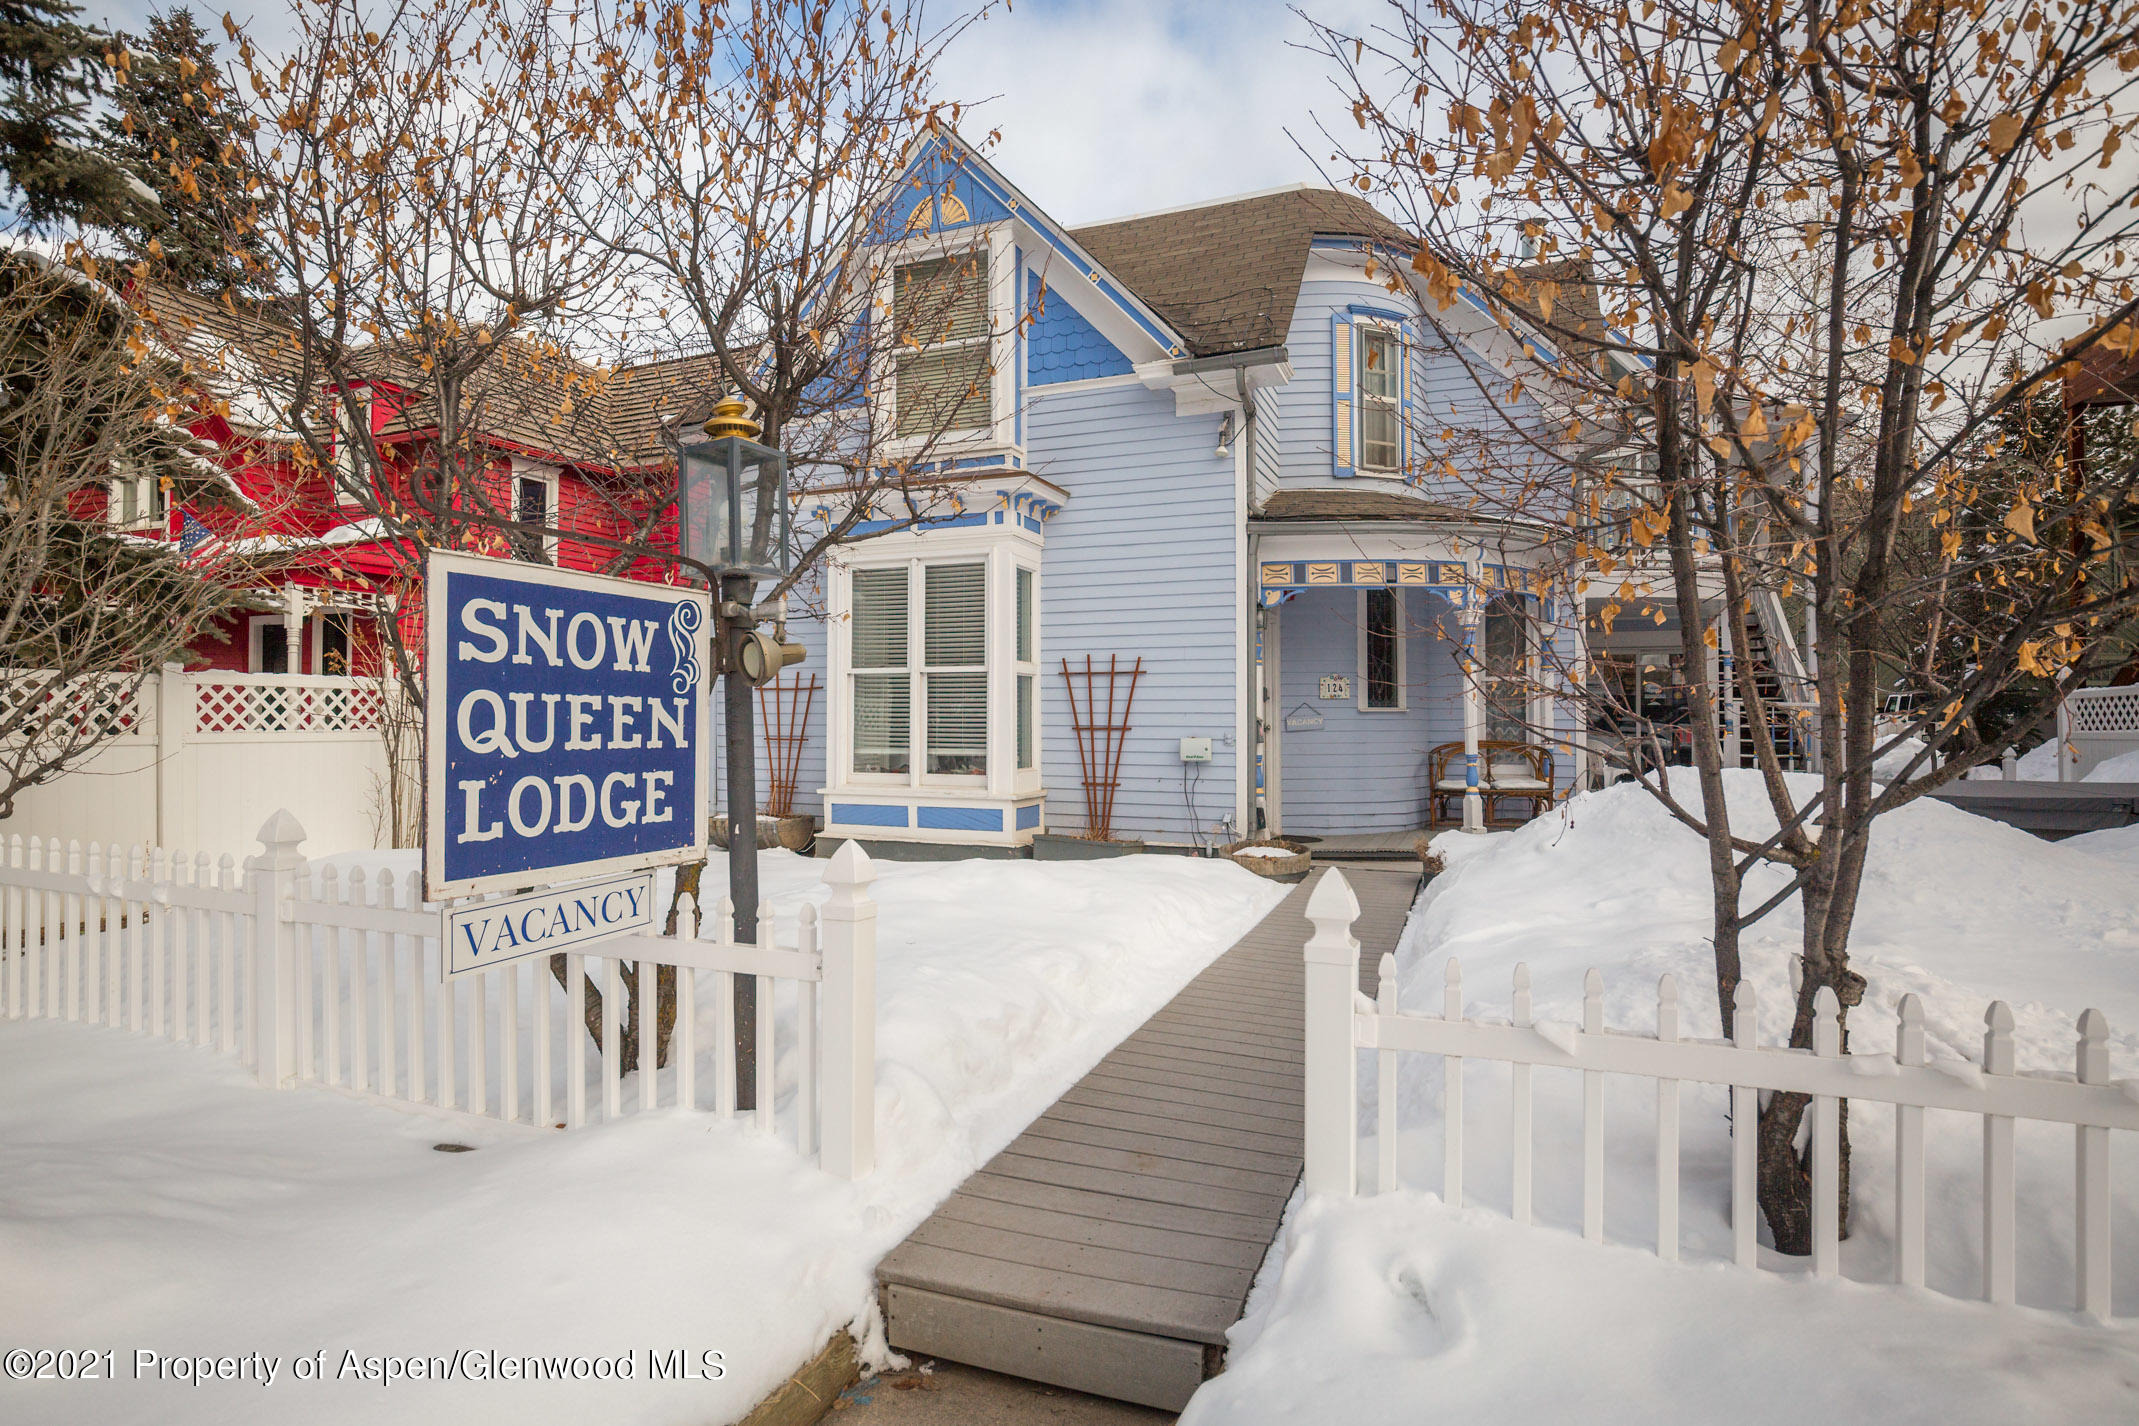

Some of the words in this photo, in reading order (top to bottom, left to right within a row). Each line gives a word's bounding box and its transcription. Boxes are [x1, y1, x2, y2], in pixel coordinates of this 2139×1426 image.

[458, 598, 659, 673] SNOW
[456, 688, 689, 758] QUEEN
[1286, 717, 1324, 726] VACANCY
[457, 770, 675, 844] LODGE
[460, 885, 646, 957] VACANCY
